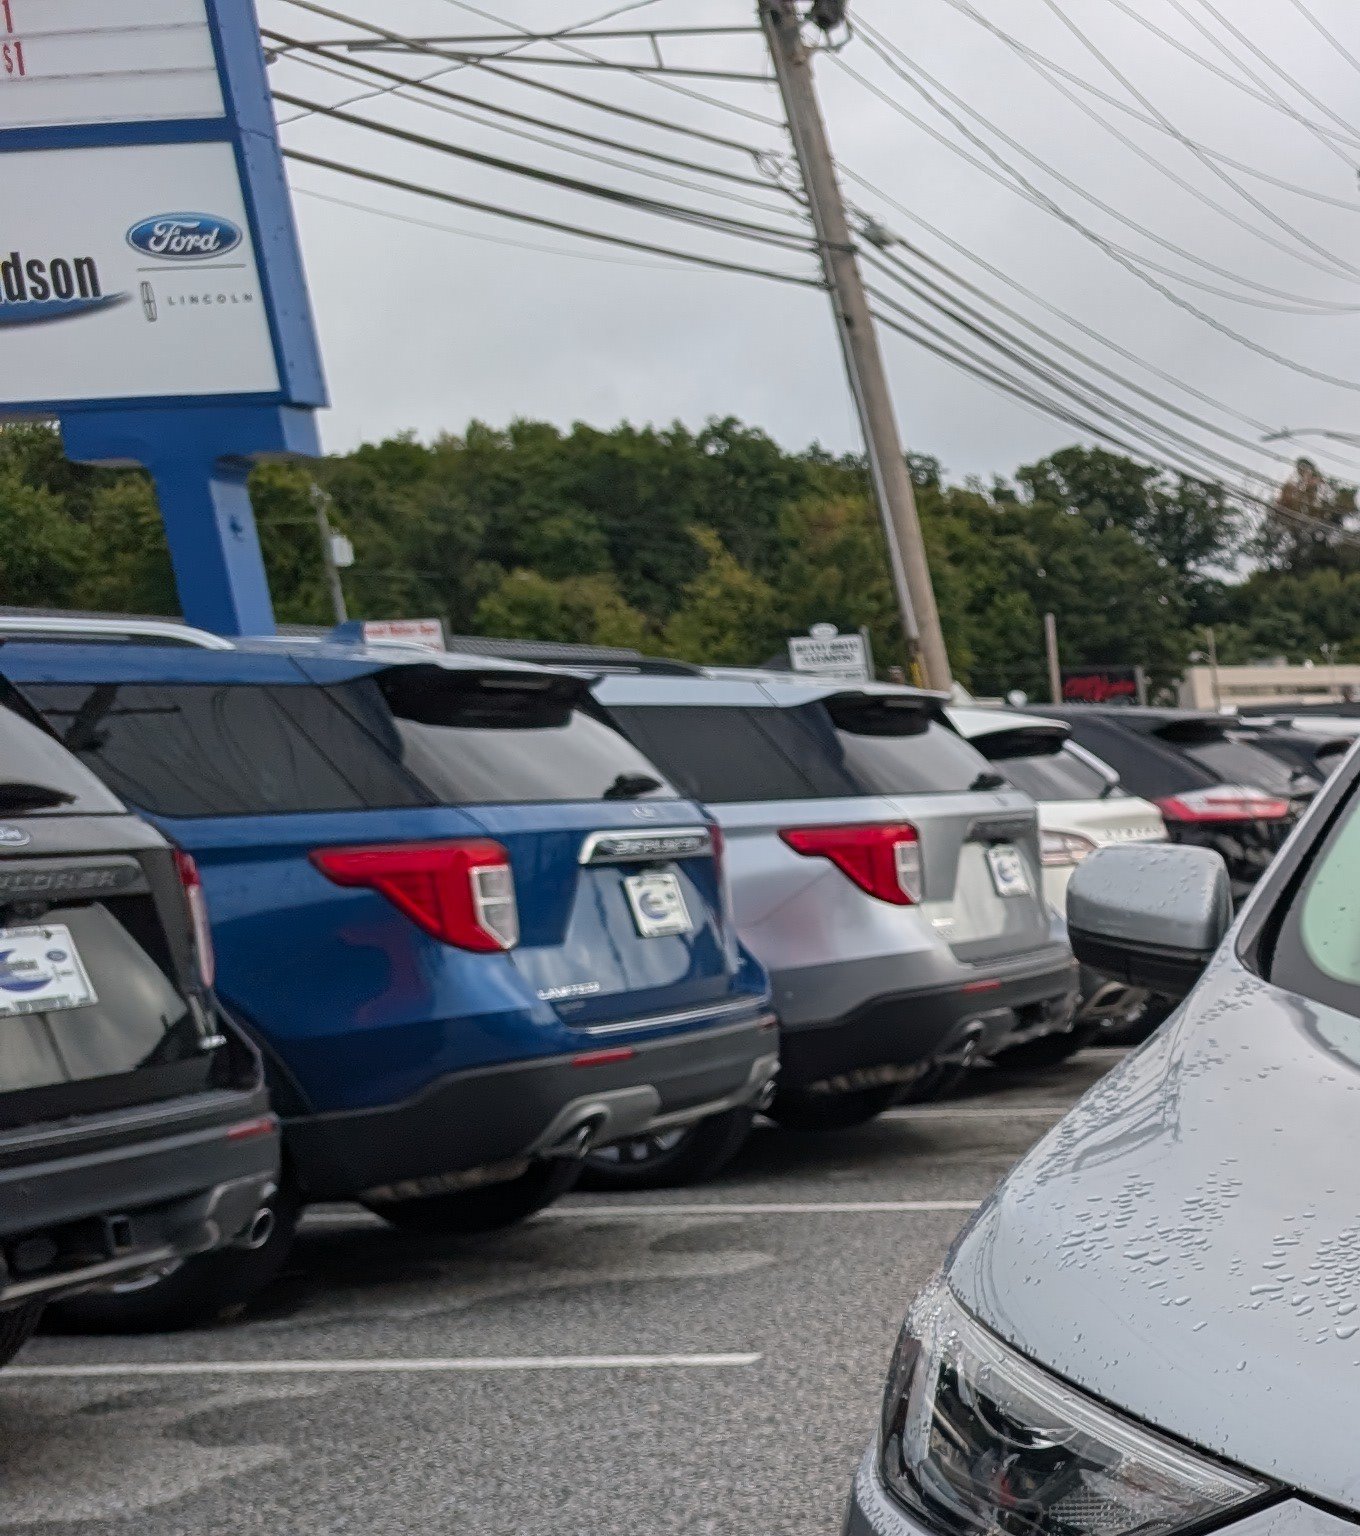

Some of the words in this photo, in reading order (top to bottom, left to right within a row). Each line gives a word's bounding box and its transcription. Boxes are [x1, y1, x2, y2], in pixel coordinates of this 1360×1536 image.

[148, 220, 220, 252] Ford
[0, 251, 102, 302] dson
[168, 293, 253, 306] LINCOLN
